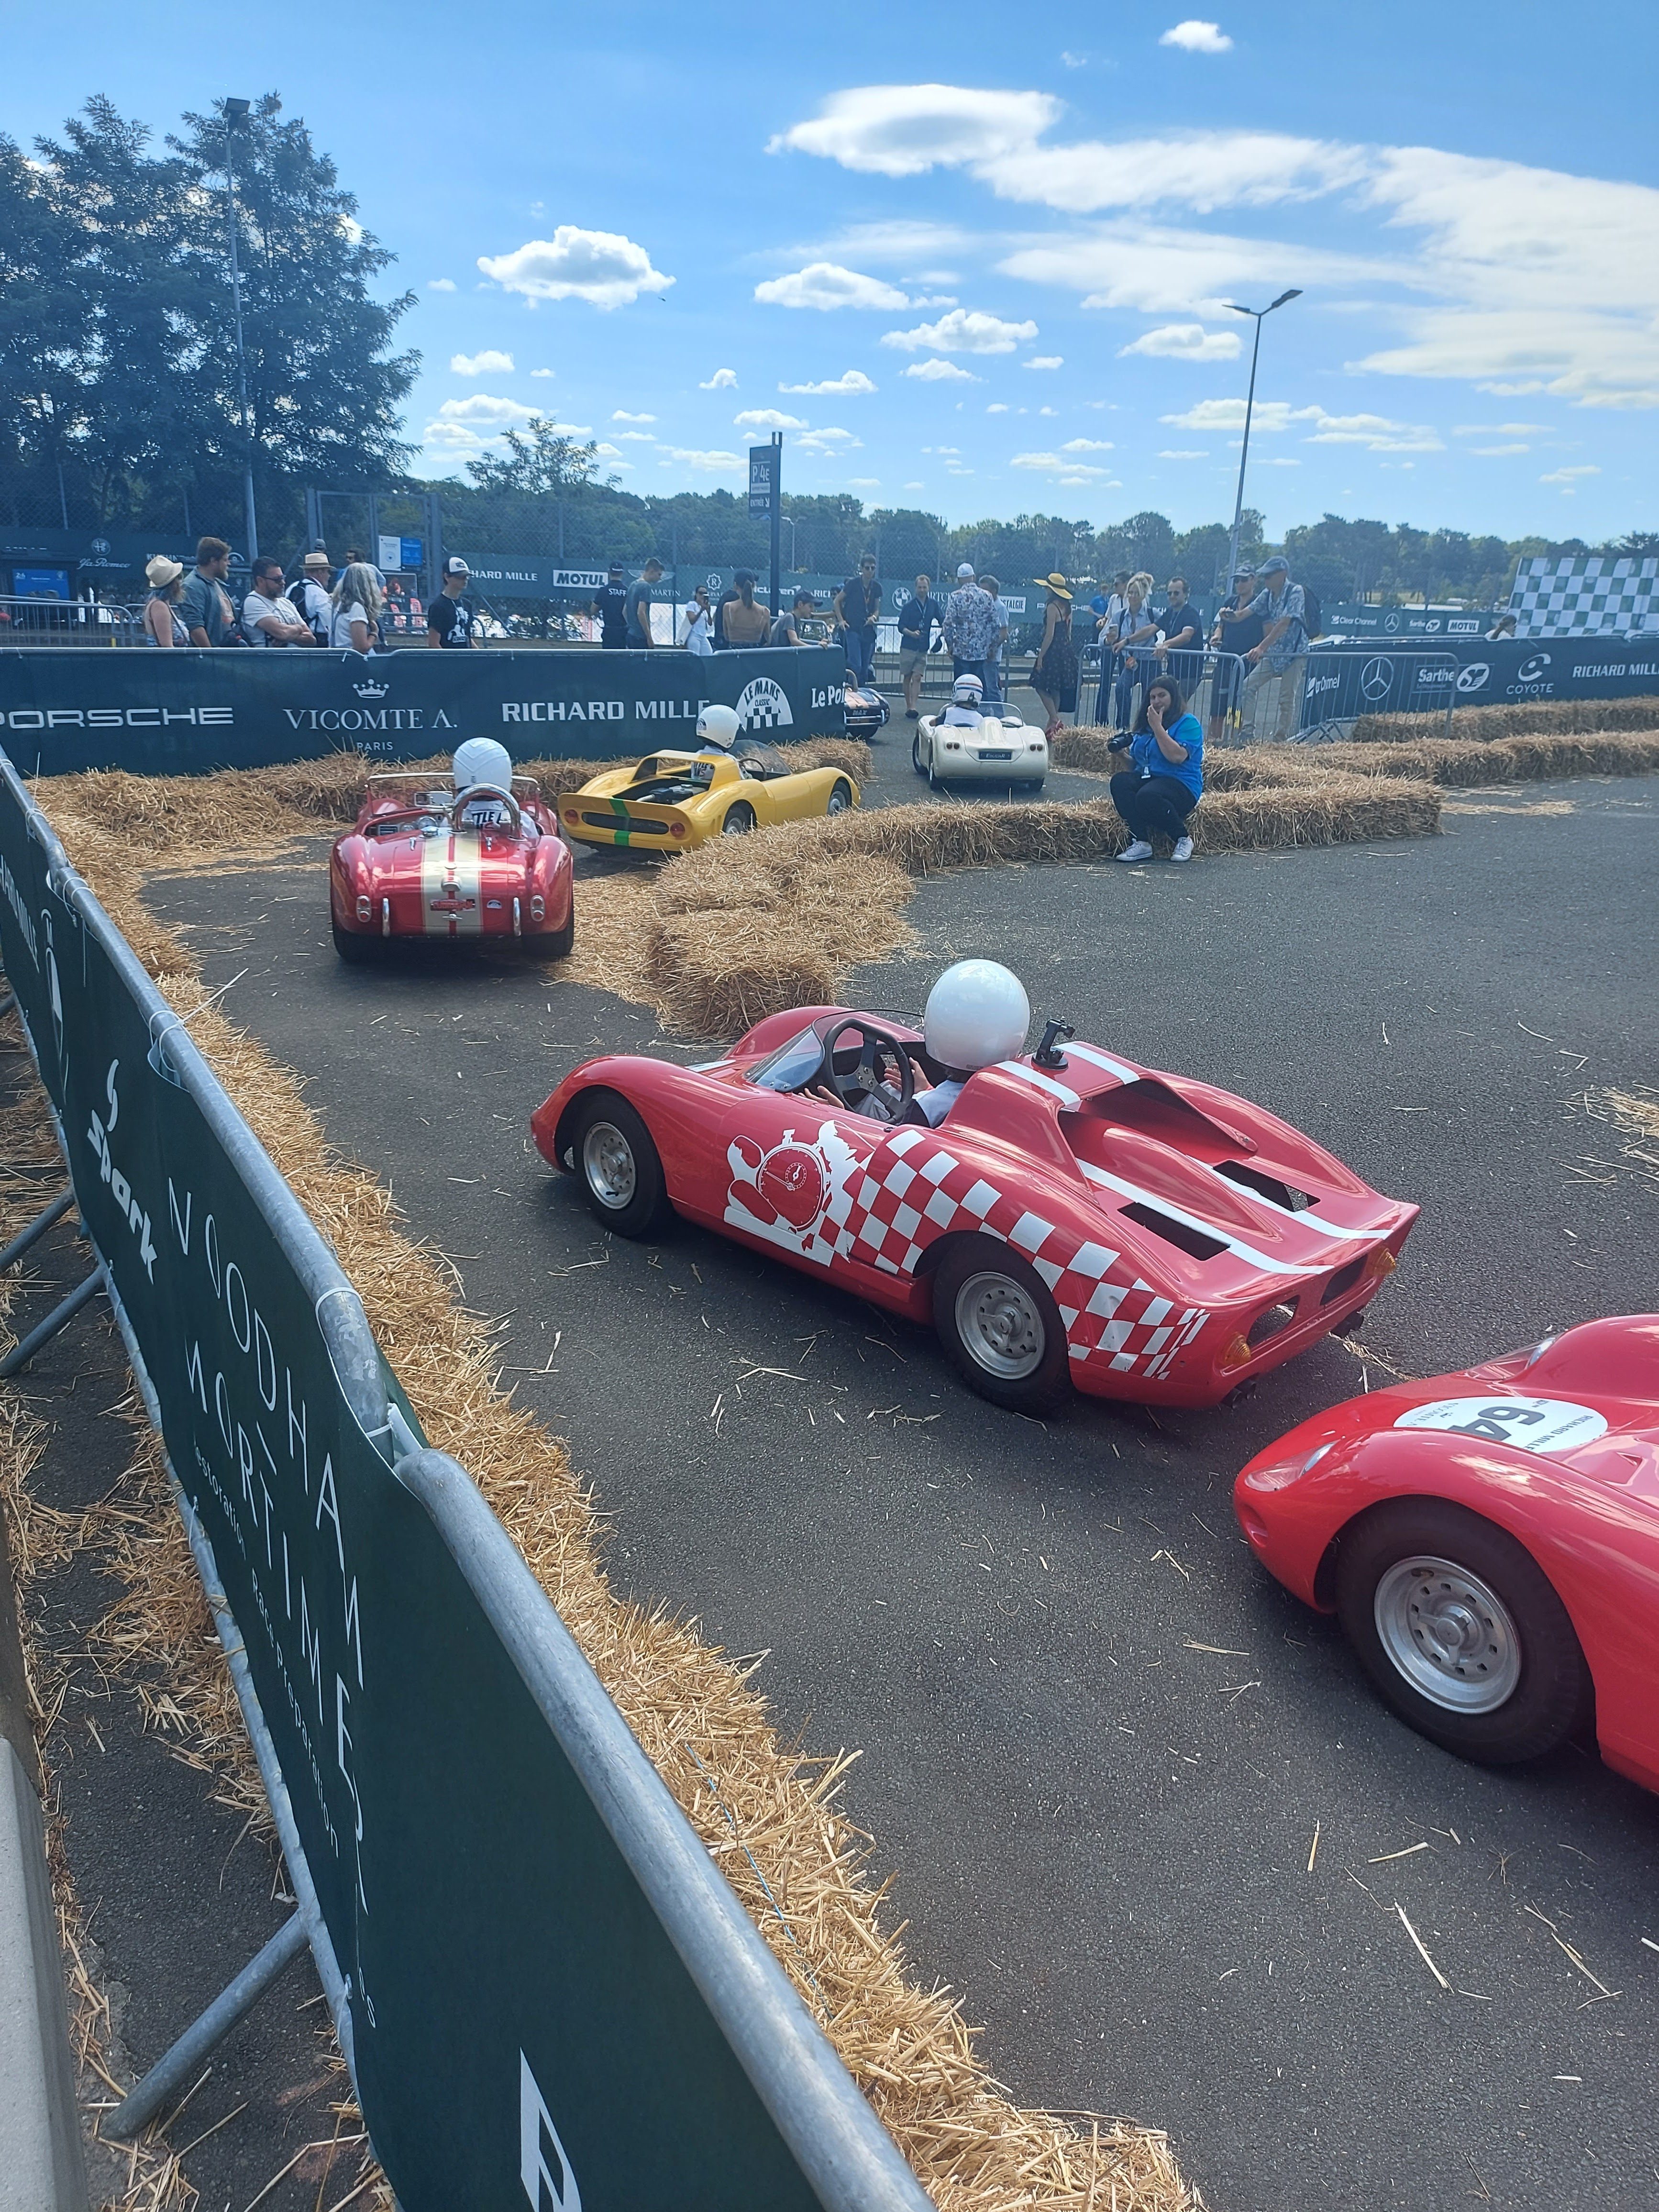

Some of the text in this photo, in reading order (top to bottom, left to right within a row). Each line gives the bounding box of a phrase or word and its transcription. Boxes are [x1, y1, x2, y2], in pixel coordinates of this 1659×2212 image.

[505, 572, 538, 581] MILLE
[556, 573, 606, 586] MOTUL
[608, 588, 627, 597] STAFF
[651, 588, 681, 597] MARTIN
[1449, 621, 1477, 631] MOTUL
[1417, 668, 1454, 683] Sarthe
[1572, 662, 1659, 678] RICHARD MILL
[744, 680, 780, 704] LE MANS
[1506, 683, 1554, 695] COYOTE
[811, 688, 826, 708] Le
[283, 708, 424, 730] VICOMTE
[502, 701, 624, 722] RICHARD
[356, 741, 394, 752] PARIS
[1448, 1406, 1546, 1441] 64
[1551, 1415, 1594, 1435] RICHARD
